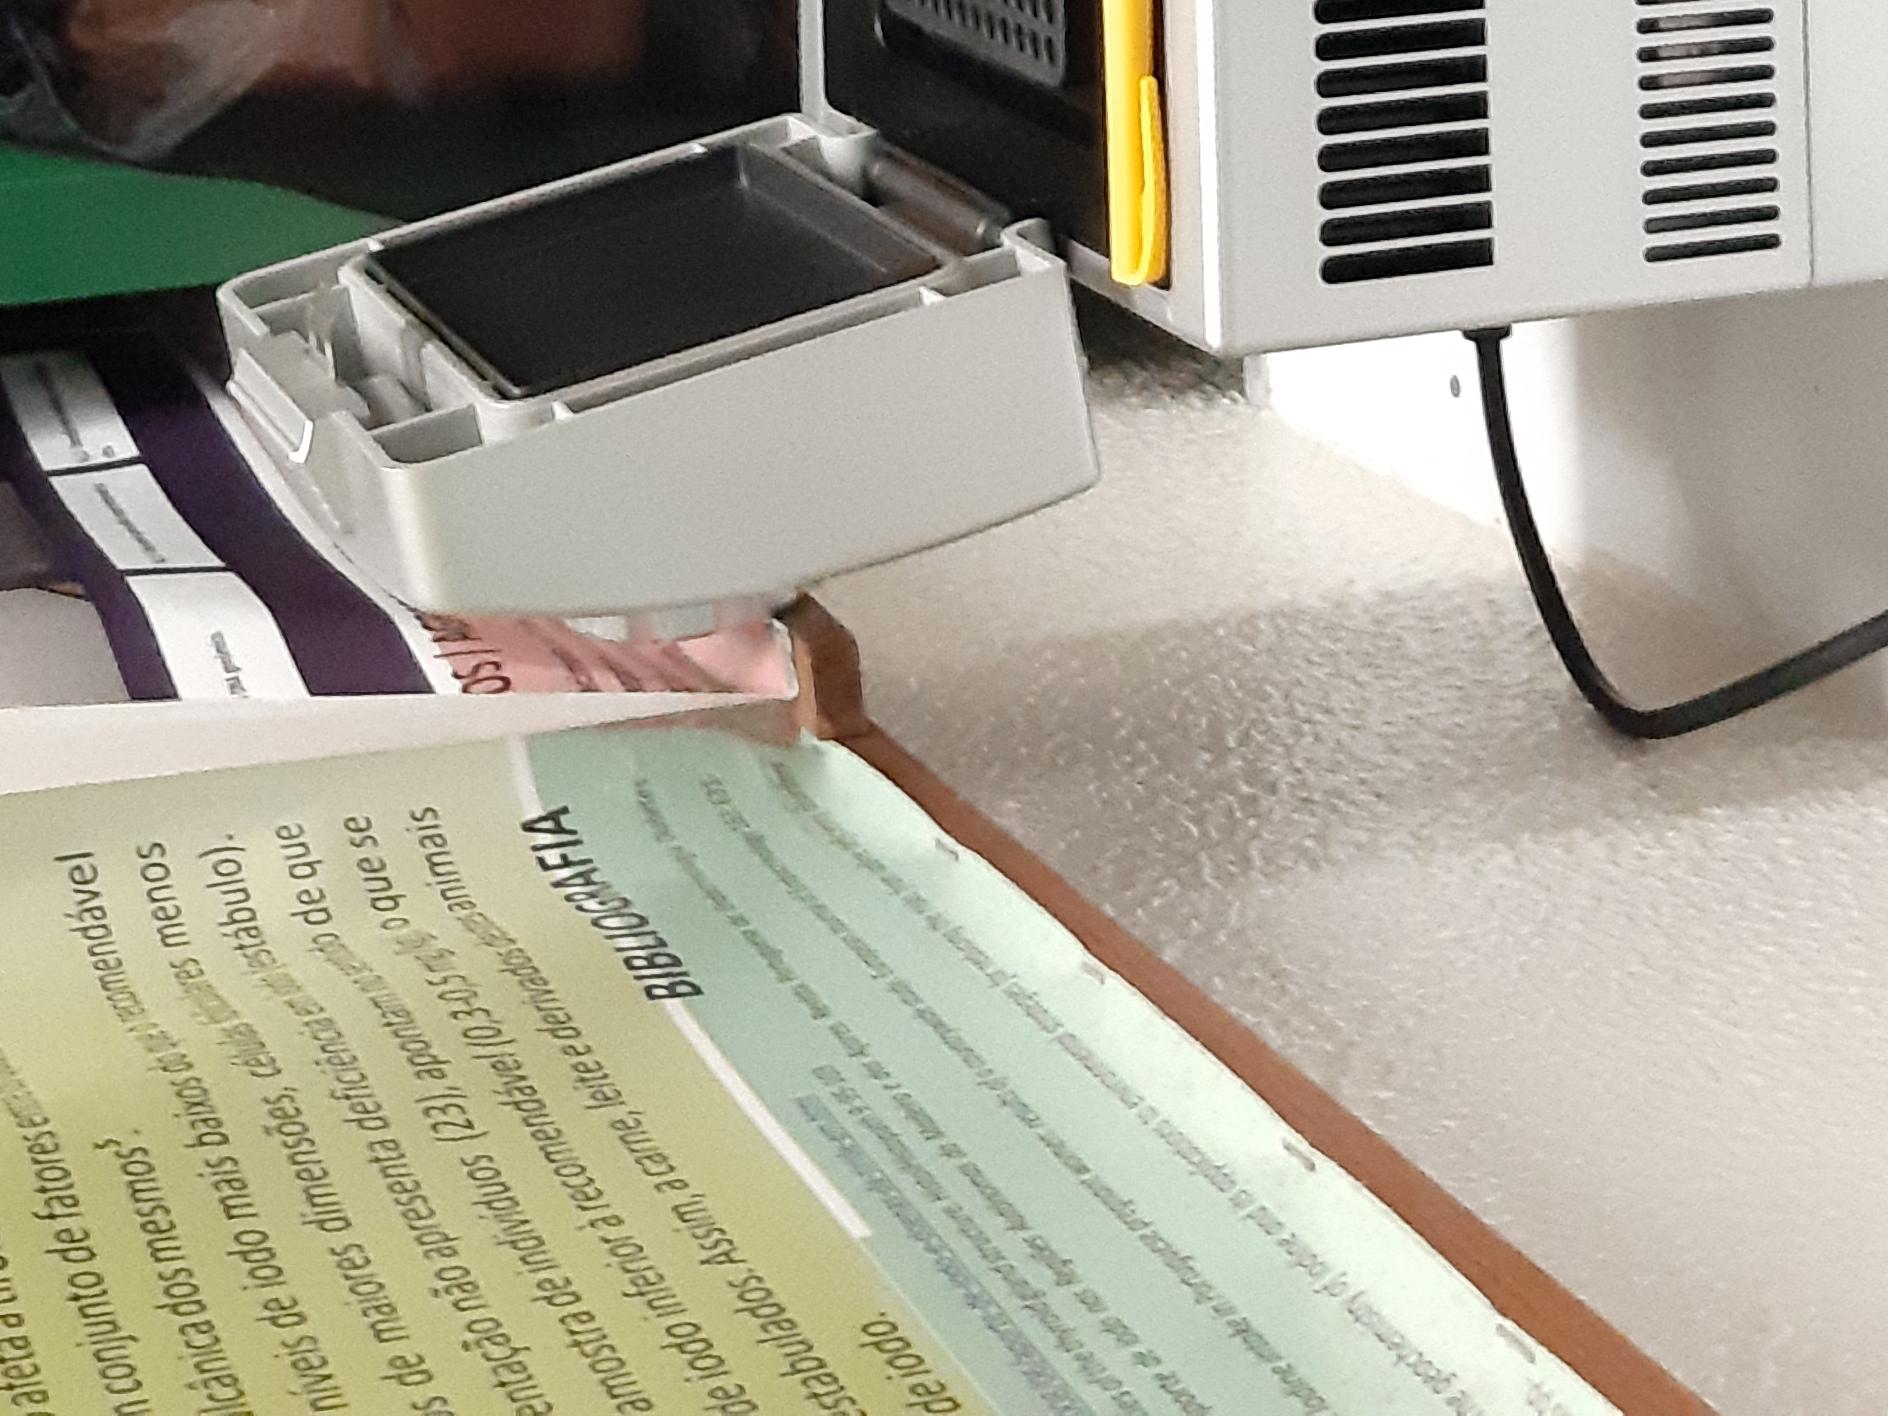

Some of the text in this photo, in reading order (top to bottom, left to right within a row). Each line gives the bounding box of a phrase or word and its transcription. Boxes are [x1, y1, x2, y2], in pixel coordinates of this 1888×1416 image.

[274, 822, 324, 880] que
[341, 815, 380, 849] se
[405, 804, 479, 913] animais
[135, 841, 192, 949] menos
[289, 888, 334, 927] de
[354, 856, 407, 913] que
[518, 804, 705, 1003] BIBLIOGRAFIA
[378, 917, 411, 931] o
[498, 946, 583, 1041] derivados
[296, 1016, 392, 1132] deficiência
[561, 1043, 593, 1058] e
[172, 1076, 230, 1148] baixos
[572, 1060, 628, 1111] leite
[262, 1086, 353, 1233] dimensões,
[471, 1052, 612, 1213] recomendável
[608, 1109, 679, 1177] carne,
[22, 1130, 85, 1221] fatores
[196, 1155, 259, 1220] mais
[366, 1138, 463, 1260] apresenta
[653, 1177, 691, 1192] a
[43, 1227, 98, 1264] de
[460, 1154, 561, 1274] indivíduos
[575, 1213, 626, 1231] à
[667, 1192, 748, 1266] Assim,
[153, 1267, 208, 1316] dos
[225, 1229, 288, 1291] iodo
[427, 1265, 489, 1313] não
[530, 1277, 583, 1307] de
[596, 1232, 691, 1320] inferior
[256, 1296, 309, 1329] de
[327, 1243, 411, 1344] maiores
[65, 1270, 141, 1395] conjunto
[558, 1310, 655, 1413] amostra
[659, 1321, 731, 1382] iodo
[857, 1310, 962, 1414] de iodo.
[273, 1334, 350, 1412] níveis
[379, 1353, 434, 1387] de
[704, 1383, 760, 1415] de
